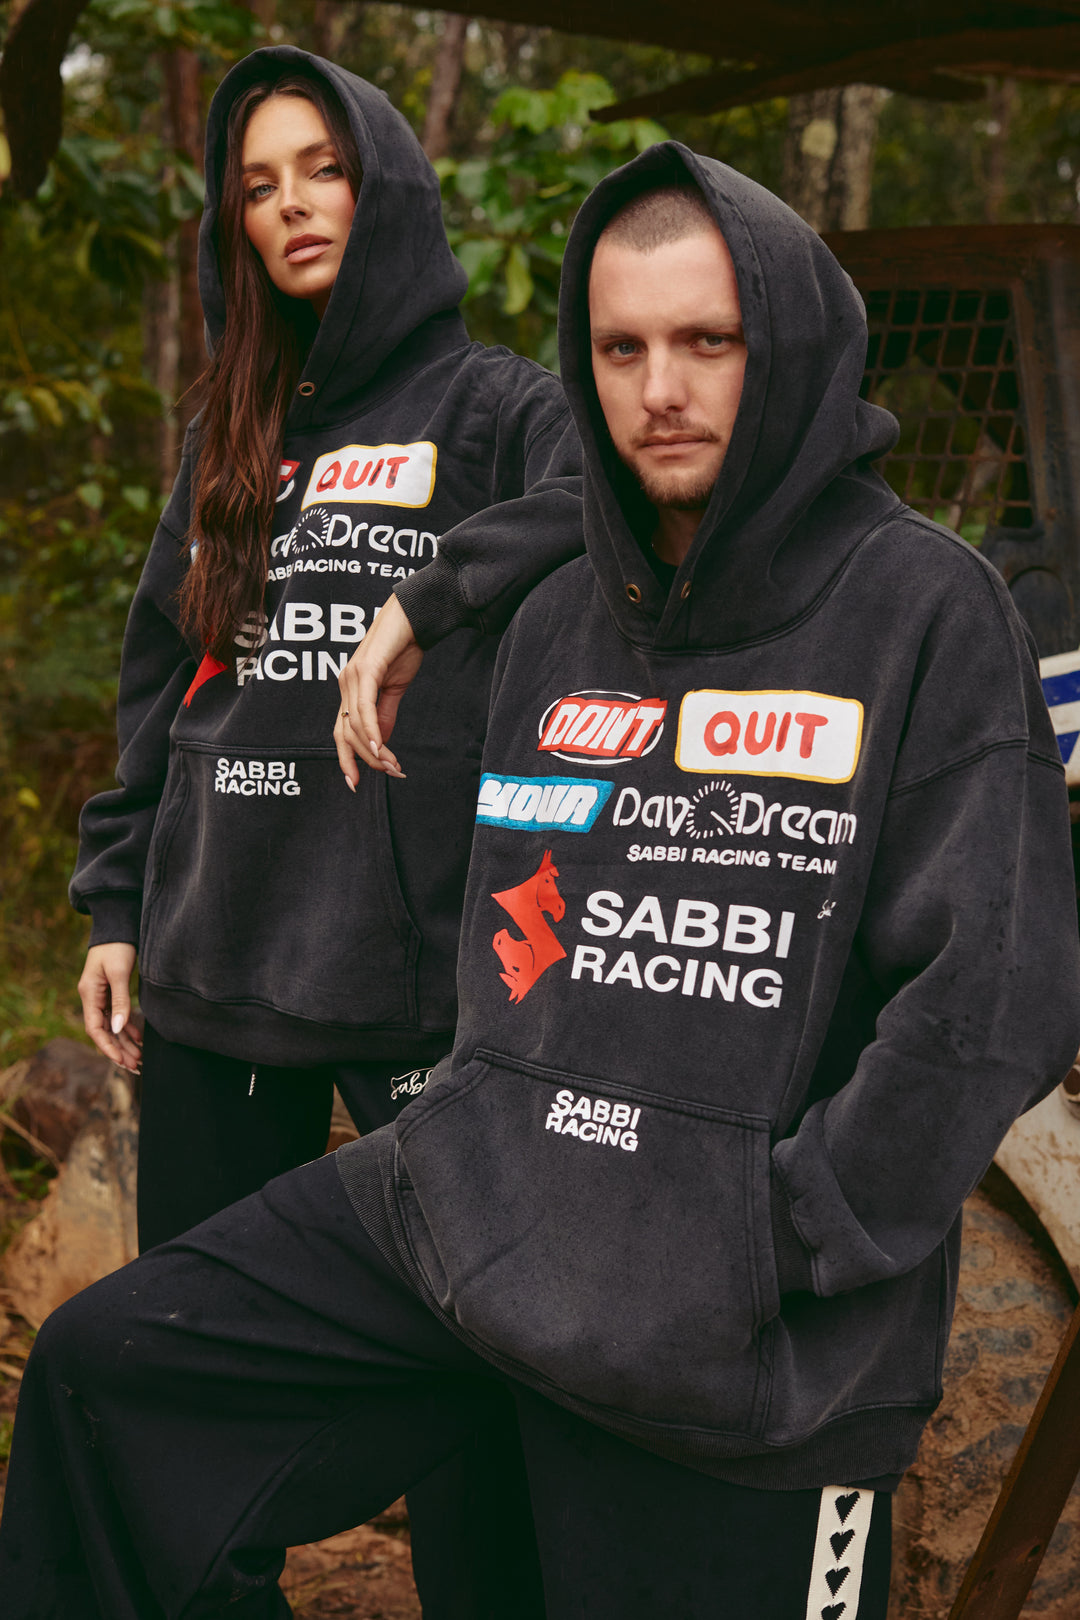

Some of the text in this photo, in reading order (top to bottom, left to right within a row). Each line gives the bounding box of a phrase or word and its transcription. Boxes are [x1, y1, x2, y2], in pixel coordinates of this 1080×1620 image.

[316, 456, 410, 493] QUIT
[294, 559, 362, 574] RACING
[703, 710, 829, 759] QUIT
[214, 777, 301, 796] RACING
[215, 757, 296, 780] SABBI
[626, 844, 838, 876] SABBI RACING TEAM
[580, 890, 796, 959] SABBI
[570, 944, 784, 1009] RACING
[550, 1089, 641, 1130] SABBI
[544, 1112, 640, 1153] RACING
